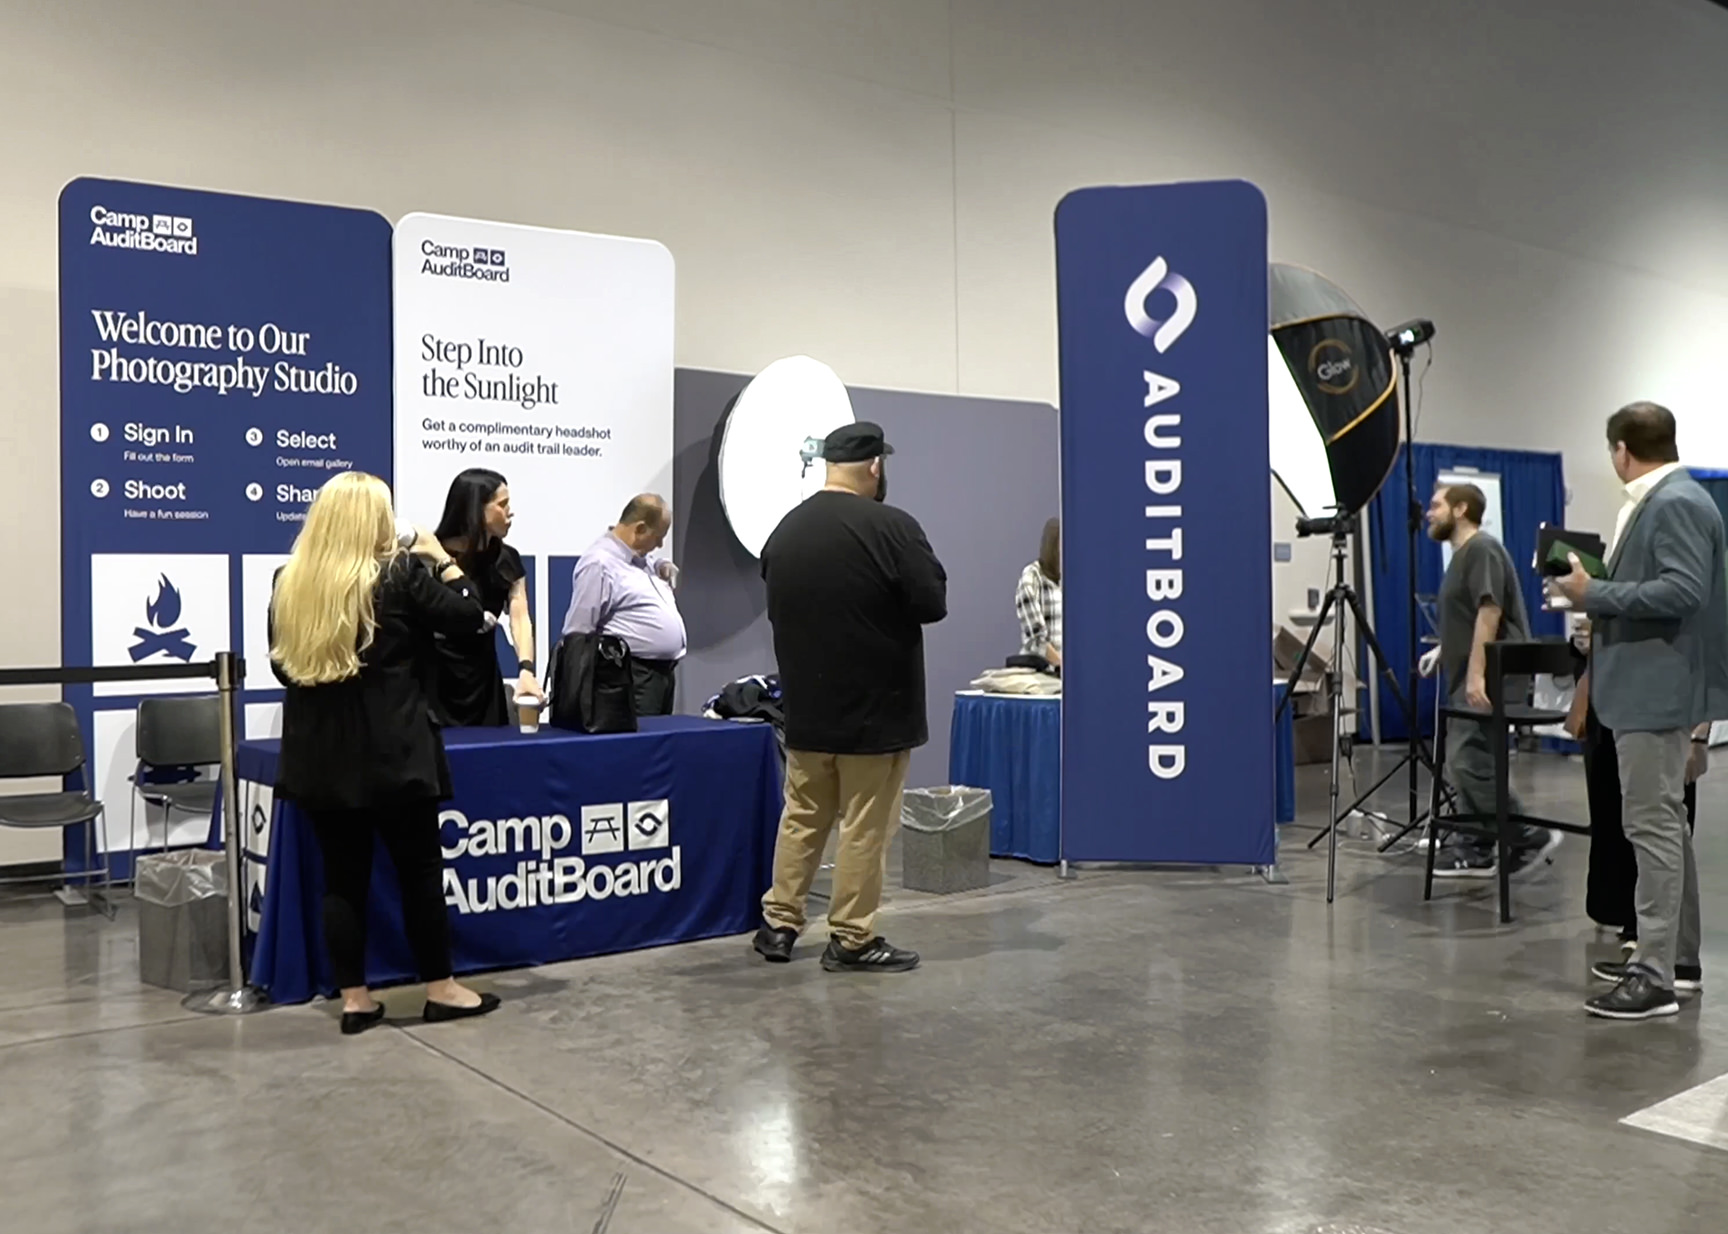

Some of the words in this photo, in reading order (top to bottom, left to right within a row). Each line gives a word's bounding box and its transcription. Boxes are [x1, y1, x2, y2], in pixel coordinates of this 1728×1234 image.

[90, 205, 150, 231] Camp
[90, 226, 198, 255] AuditBoard
[421, 239, 470, 263] Camp
[421, 258, 510, 283] AuditBoard
[90, 309, 223, 350] Welcome
[227, 324, 255, 352] to
[258, 322, 311, 356] Our
[421, 333, 473, 371] Step
[477, 338, 524, 369] Into
[90, 348, 270, 398] Photography
[274, 361, 359, 395] Studio
[1317, 359, 1351, 380] Glow
[422, 367, 460, 399] the
[463, 371, 559, 411] Sunlight
[124, 422, 170, 447] Sign
[175, 424, 194, 444] In
[276, 429, 337, 450] Select
[421, 417, 446, 432] Get
[449, 422, 457, 432] a
[458, 422, 553, 439] complimentary
[555, 425, 611, 440] headshot
[124, 450, 137, 461] Fill
[137, 452, 154, 462] out
[155, 453, 171, 462] the
[172, 453, 195, 463] form
[421, 438, 467, 454] worthy
[469, 439, 482, 452] of
[485, 441, 501, 453] an
[503, 441, 534, 454] audit
[537, 443, 561, 455] trail
[562, 443, 603, 457] leader.
[276, 456, 300, 467] Open
[301, 459, 324, 468] email
[325, 459, 353, 469] gallery
[124, 479, 186, 500] Shoot
[276, 484, 319, 502] Shar
[124, 509, 148, 519] Have
[149, 511, 156, 519] a
[157, 509, 173, 519] fun
[174, 511, 209, 519] session
[1143, 369, 1186, 780] AUDITBOARD
[438, 808, 572, 860] Camp
[442, 845, 681, 914] AuditBoard
